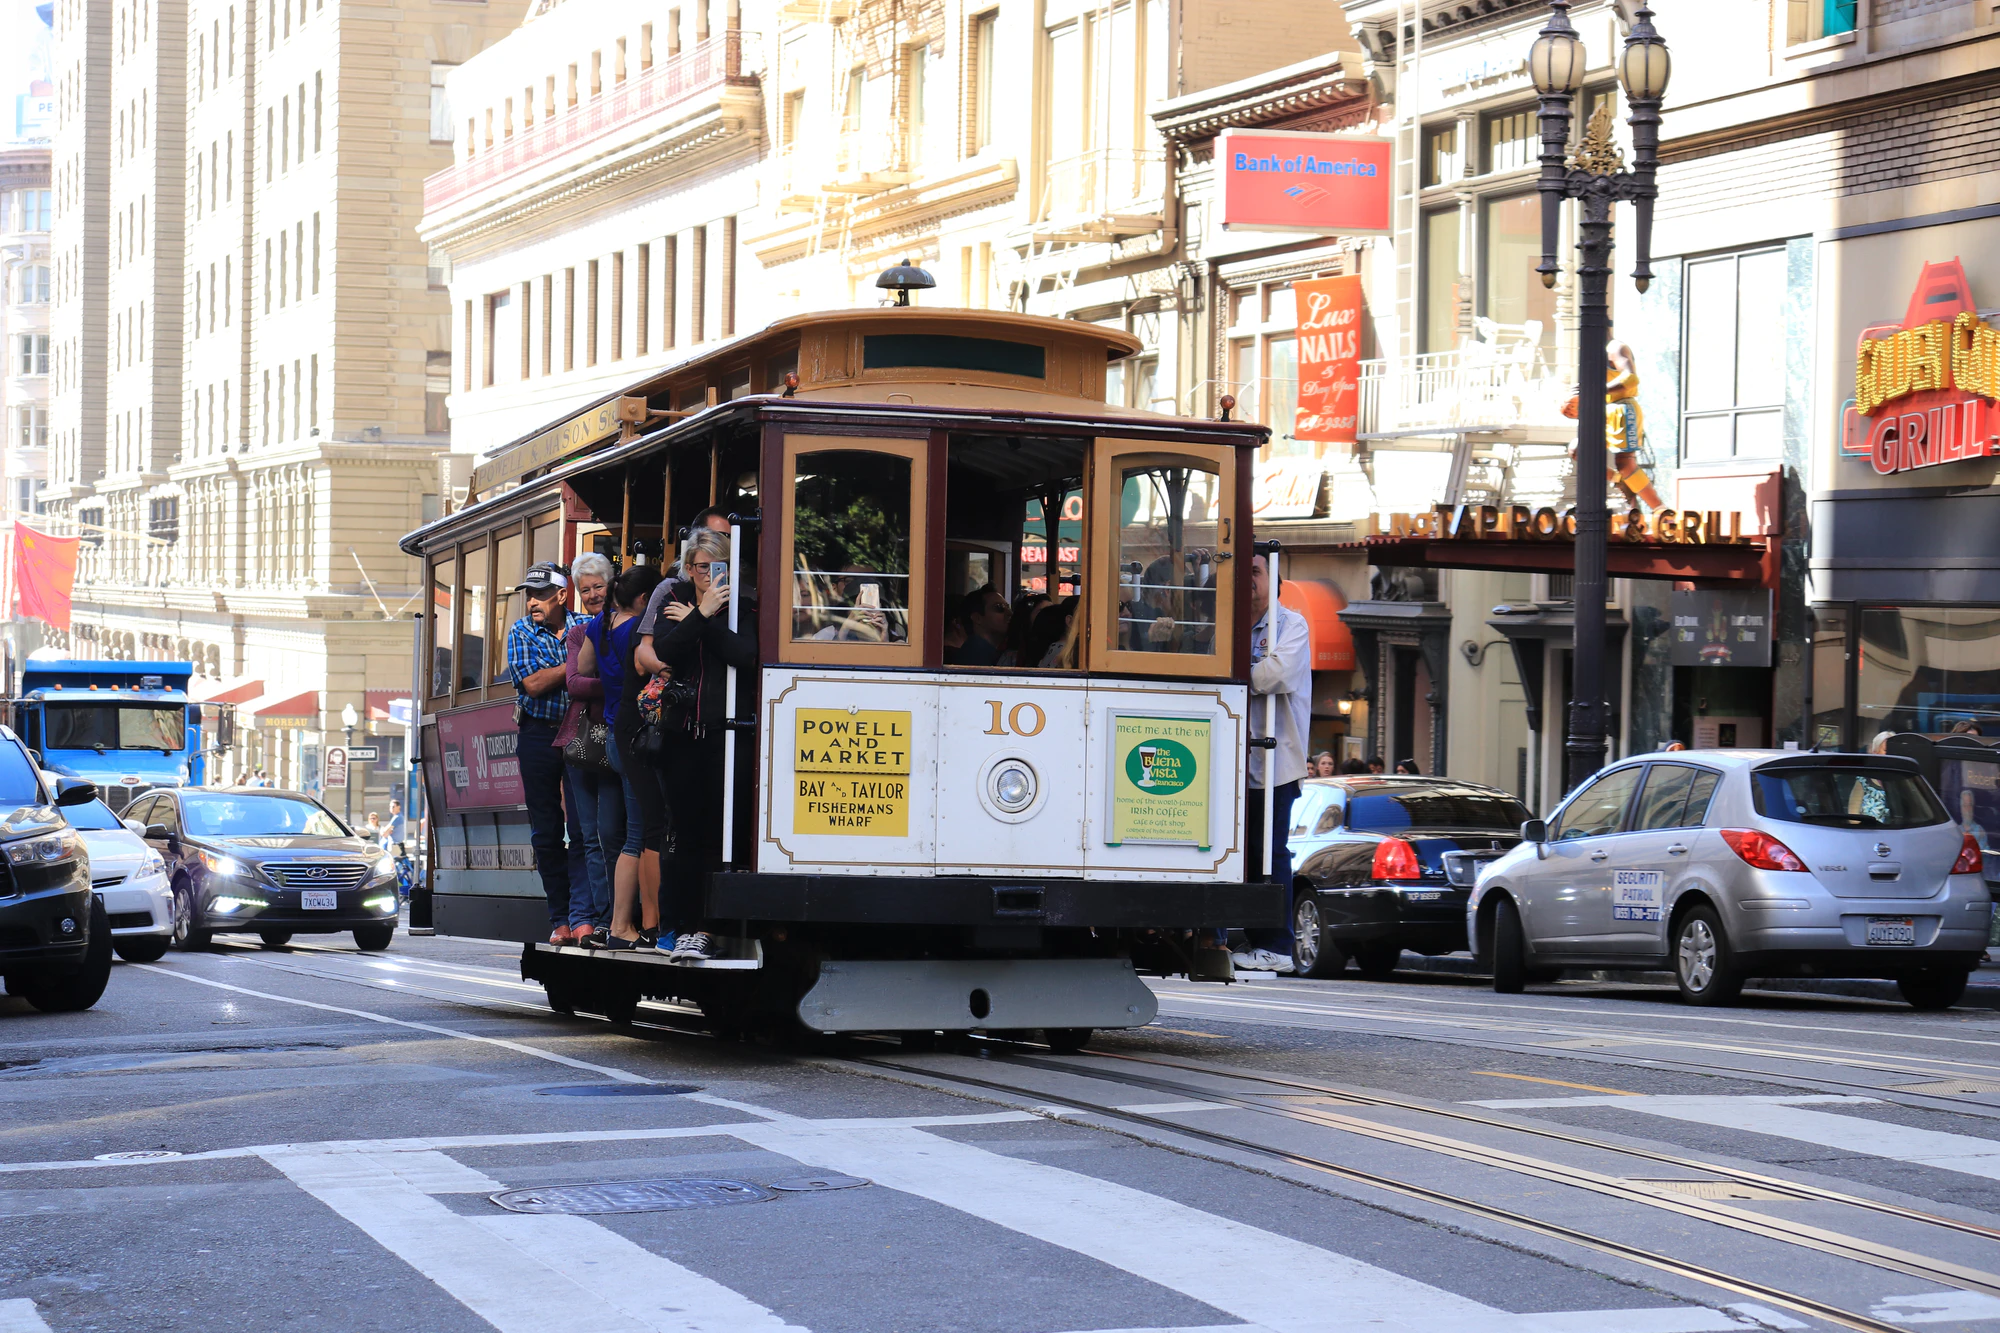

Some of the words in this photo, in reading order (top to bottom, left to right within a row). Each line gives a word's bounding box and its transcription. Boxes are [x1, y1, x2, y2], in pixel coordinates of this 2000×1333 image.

[1235, 153, 1281, 172] Bank
[1284, 155, 1303, 173] of
[1305, 156, 1377, 177] America
[1302, 292, 1356, 330] Lux
[1301, 330, 1357, 364] NAILS
[1302, 380, 1330, 404] Day
[1332, 376, 1356, 403] Spa
[1869, 399, 1985, 476] GRILL
[478, 451, 525, 489] POWELL
[544, 418, 592, 457] MASON
[1434, 504, 1499, 540] TAP
[1653, 508, 1752, 544] GRILL
[265, 717, 308, 727] MOREAU
[983, 700, 1047, 737] 10
[802, 720, 903, 737] POWELL
[487, 735, 506, 756] TOURIST
[829, 737, 879, 749] AND
[800, 749, 904, 766] MARKET
[799, 780, 825, 797] BAY
[831, 782, 847, 798] AND
[851, 781, 904, 800] TAYLOR
[808, 801, 894, 815] FISHERMANS
[1116, 796, 1134, 804] home
[1136, 797, 1143, 805] of
[828, 815, 873, 828] WHARF
[450, 849, 463, 867] SAN
[463, 848, 493, 867] FANCISCO
[1617, 872, 1659, 885] SECURITY
[304, 897, 335, 907] 7XCW434
[1622, 888, 1654, 901] PATROL
